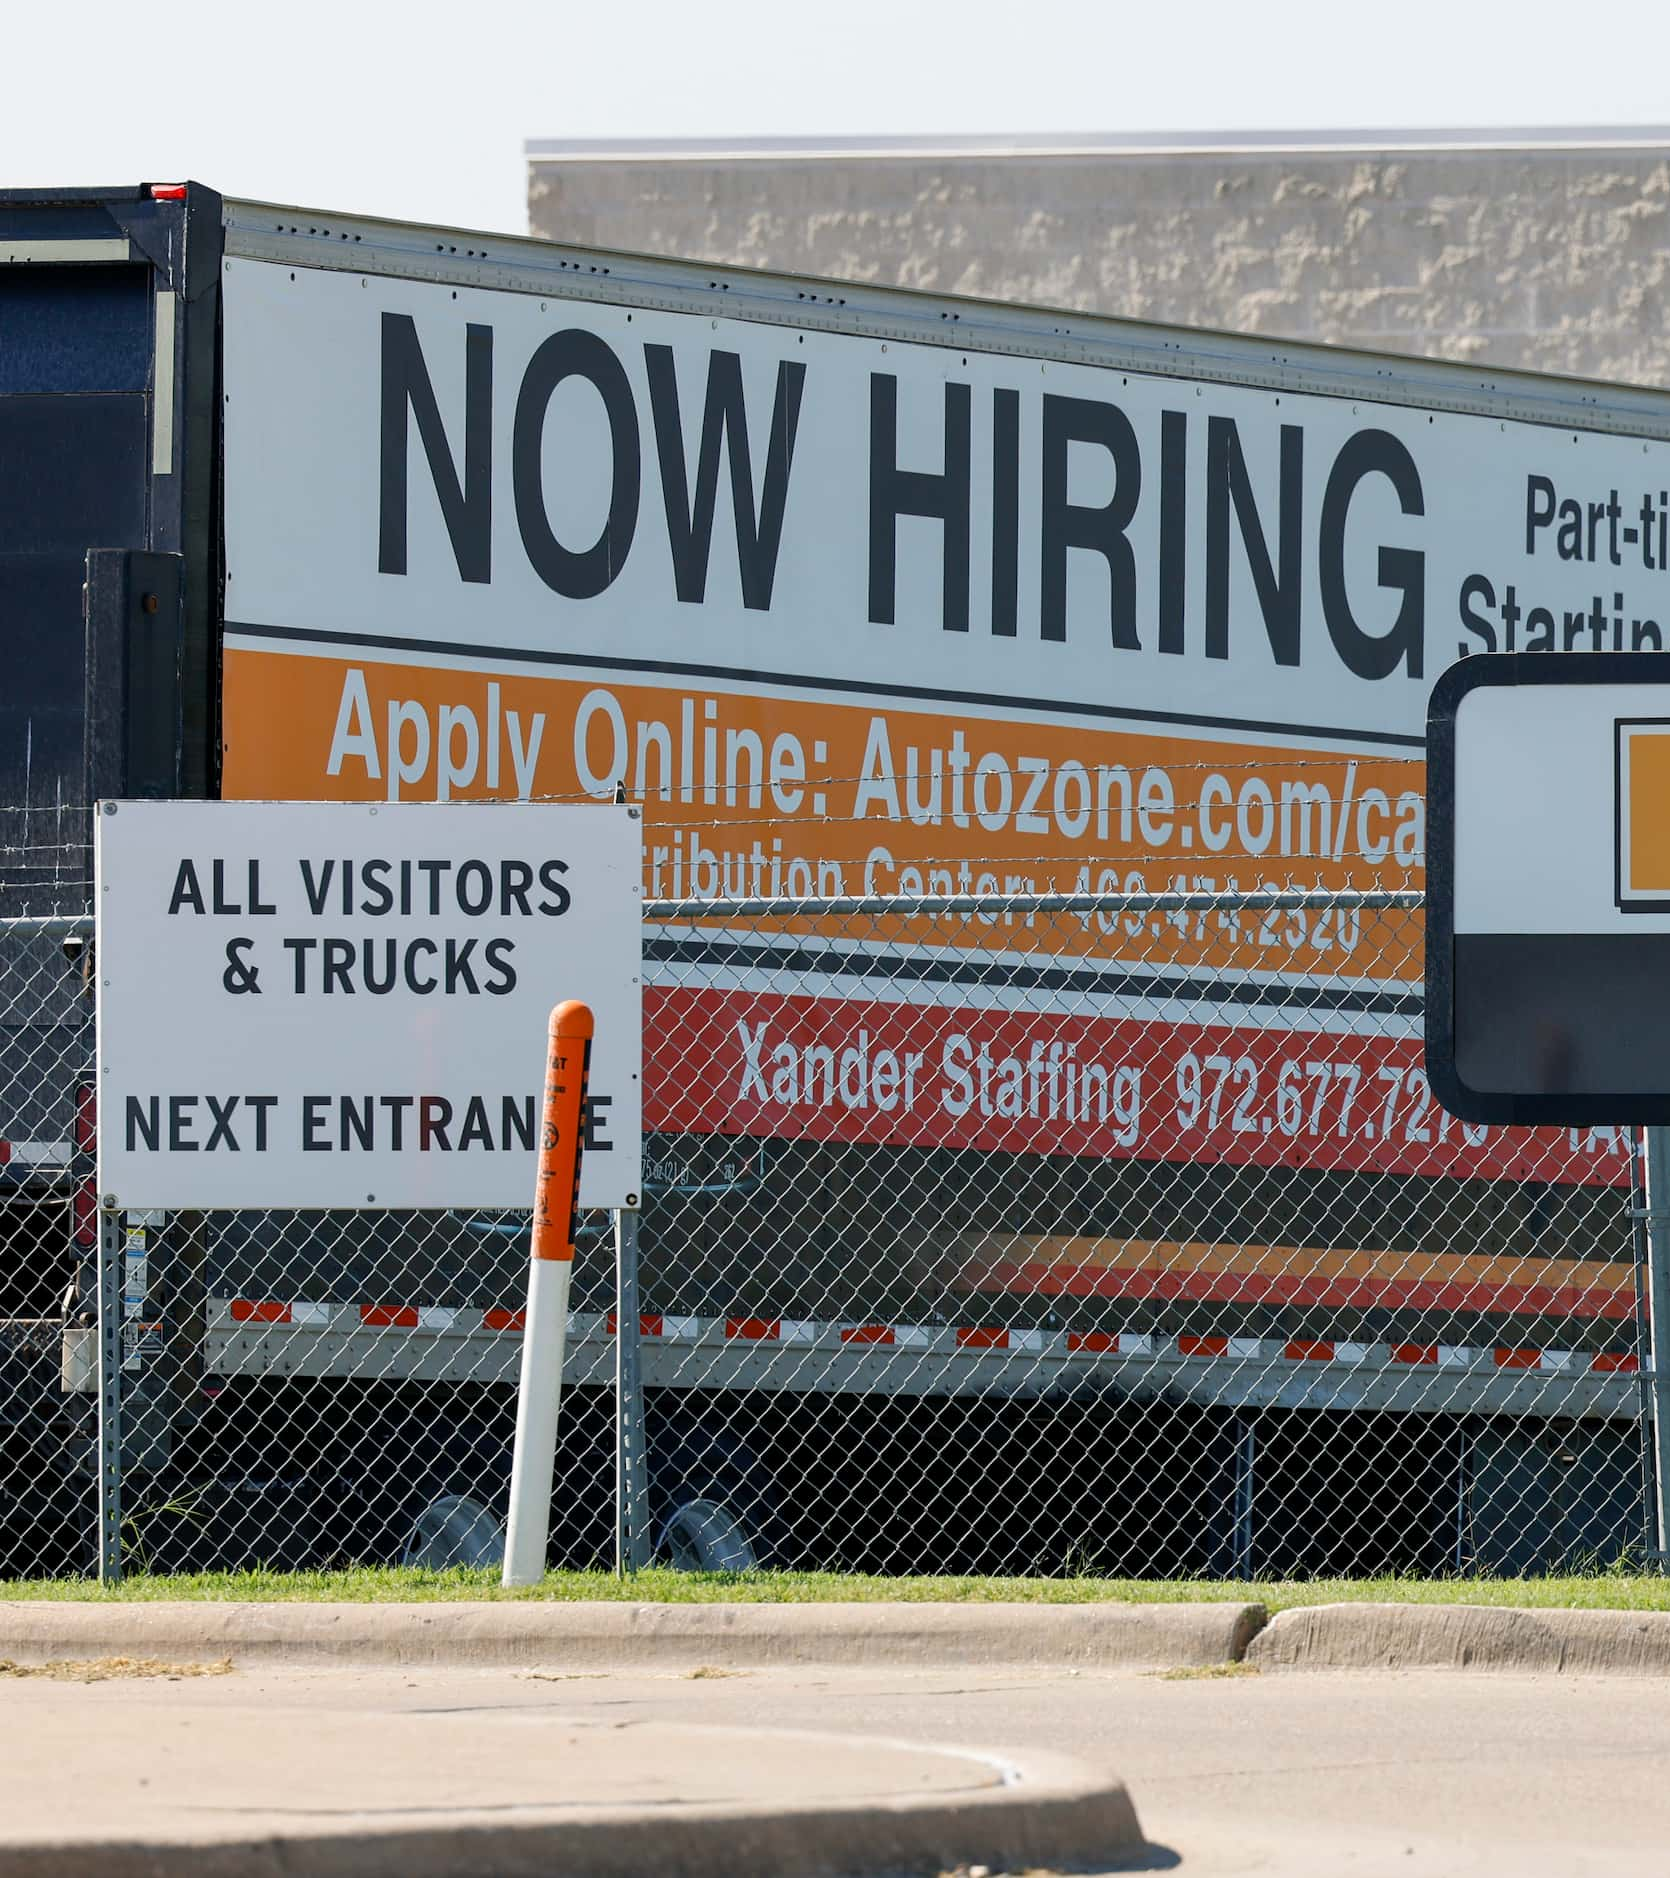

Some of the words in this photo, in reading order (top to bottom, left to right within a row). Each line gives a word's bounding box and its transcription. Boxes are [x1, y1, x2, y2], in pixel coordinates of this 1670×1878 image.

[378, 312, 806, 612] NOW
[868, 373, 1426, 681] HIRING
[326, 667, 546, 802] Apply
[574, 689, 828, 814] Online:
[852, 717, 1426, 868] Autozone.com/ca
[168, 859, 277, 915] ALL
[299, 859, 572, 917] VISITORS
[223, 937, 263, 995] &
[284, 938, 518, 996] TRUCKS
[125, 1095, 279, 1152] NEXT
[302, 1095, 614, 1152] ENTRANE
[736, 1018, 924, 1113] Xander
[940, 1033, 1141, 1148] Staffing
[1177, 1053, 1489, 1147] 972.677.72
